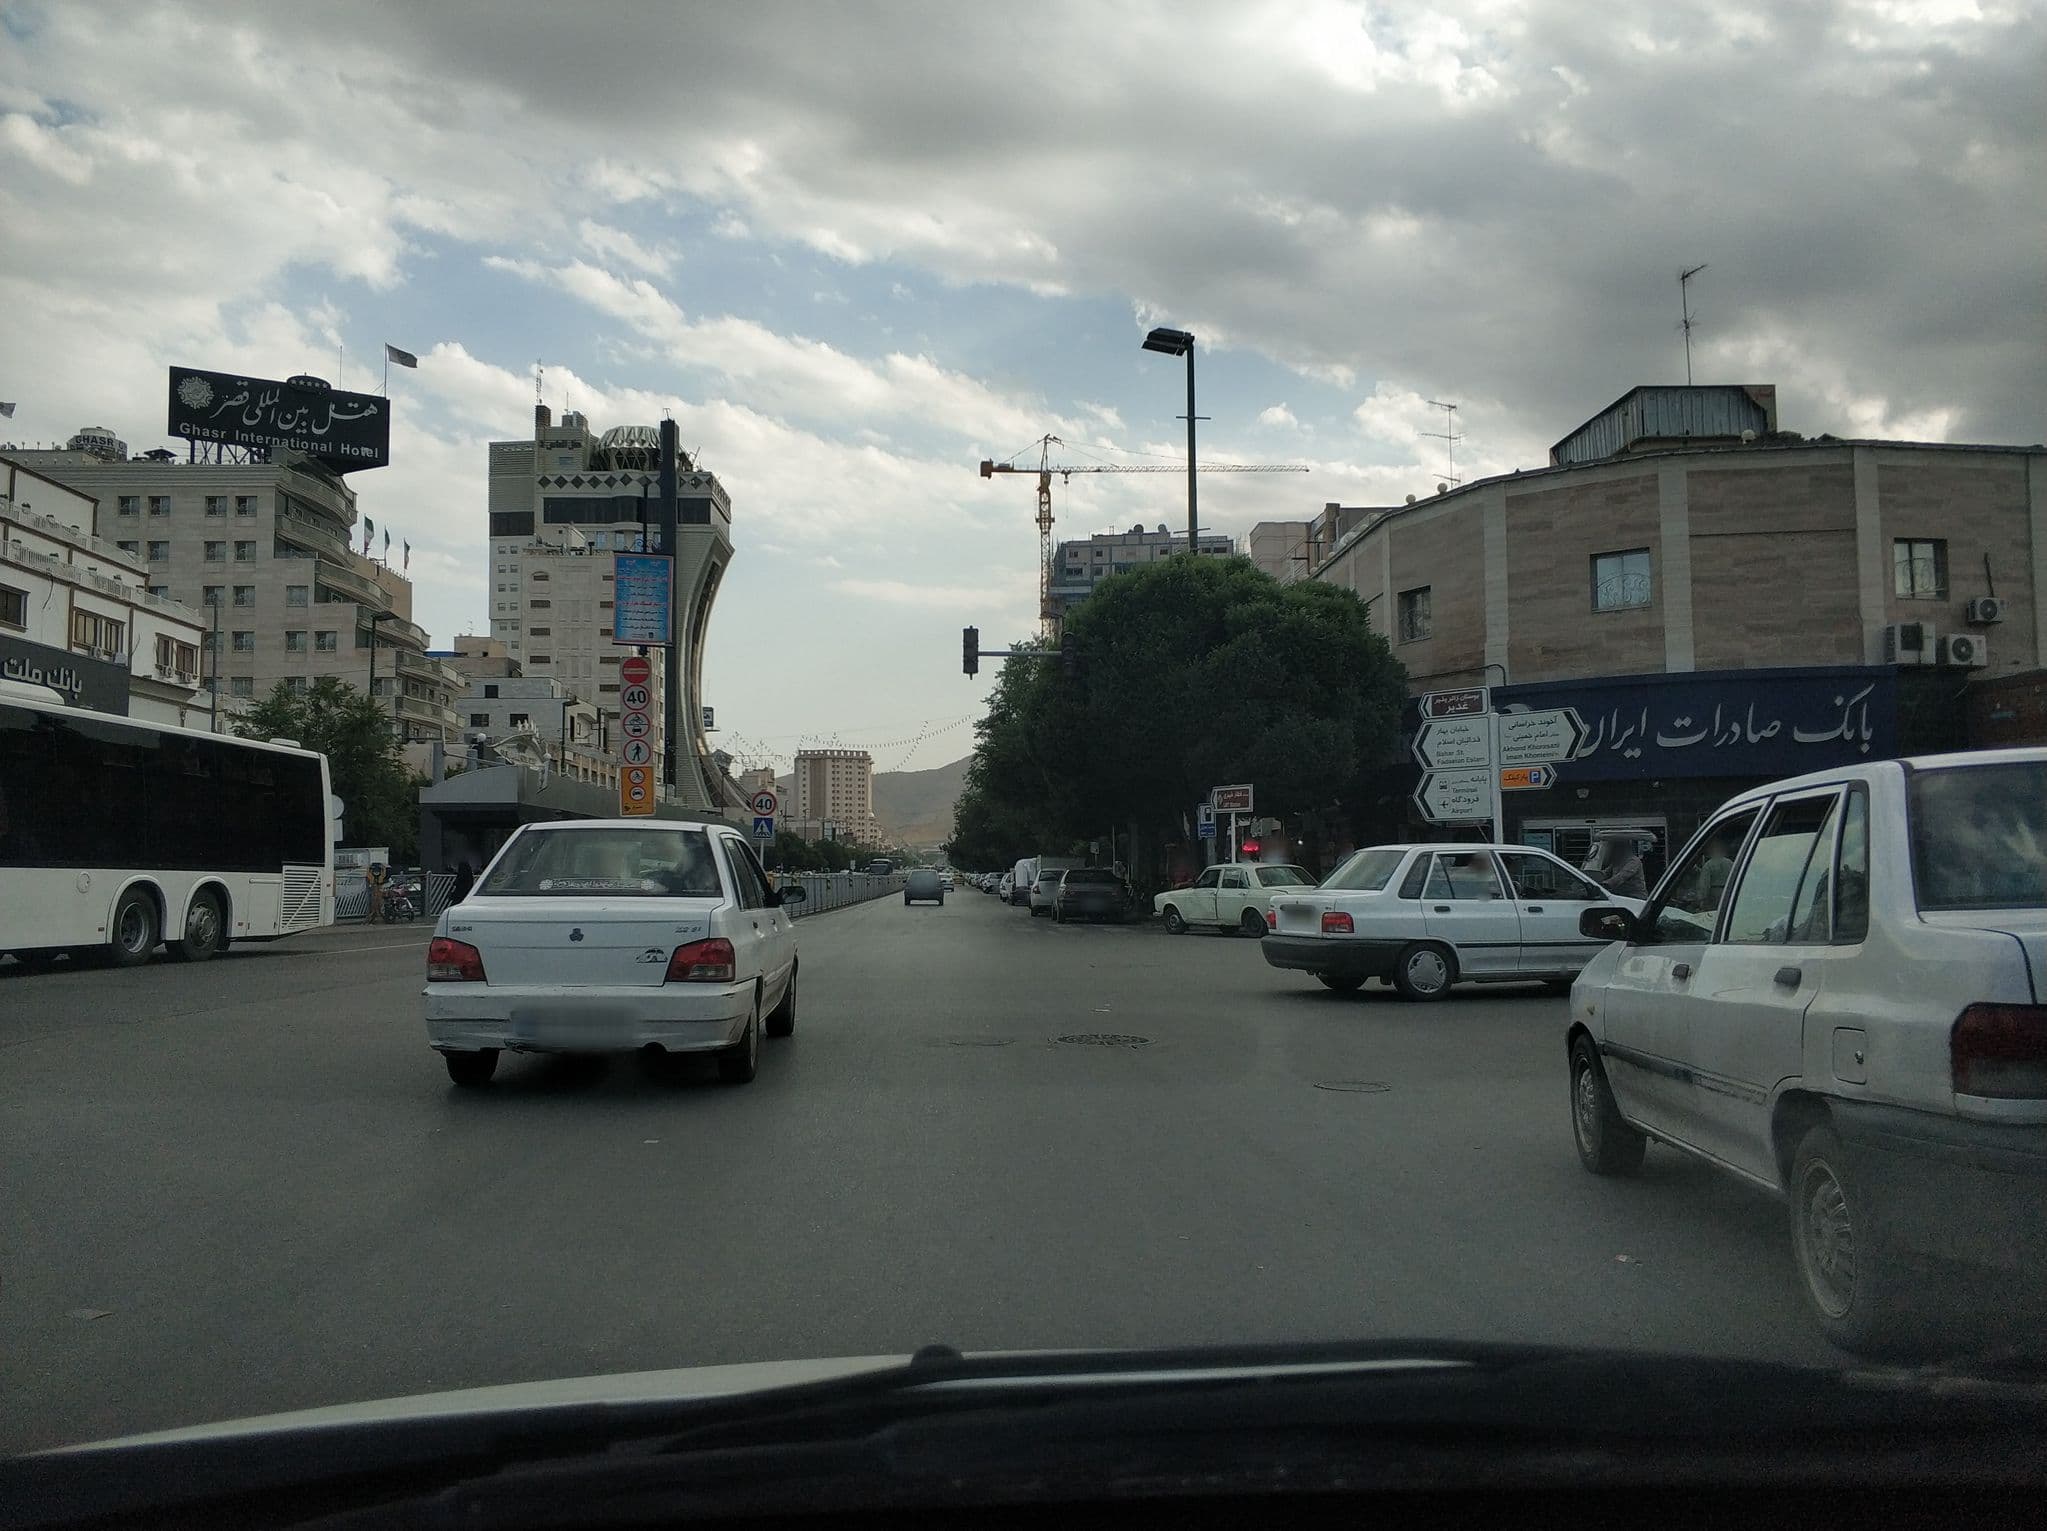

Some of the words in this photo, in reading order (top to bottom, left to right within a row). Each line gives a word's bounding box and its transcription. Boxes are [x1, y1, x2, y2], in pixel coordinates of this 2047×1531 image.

[209, 380, 250, 419] قصر
[277, 405, 309, 434] بین
[312, 400, 378, 435] هتل
[75, 434, 114, 447] GHASR
[179, 422, 227, 440] Ghasr
[235, 429, 333, 453] International
[340, 442, 379, 459] Hotel
[3, 657, 42, 684] ملت
[46, 667, 83, 700] بانک
[627, 690, 647, 705] 40
[1656, 702, 1782, 748] صادرات
[1793, 683, 1876, 754] بانک
[755, 797, 773, 812] 40
[1451, 795, 1479, 805] فرودگاه
